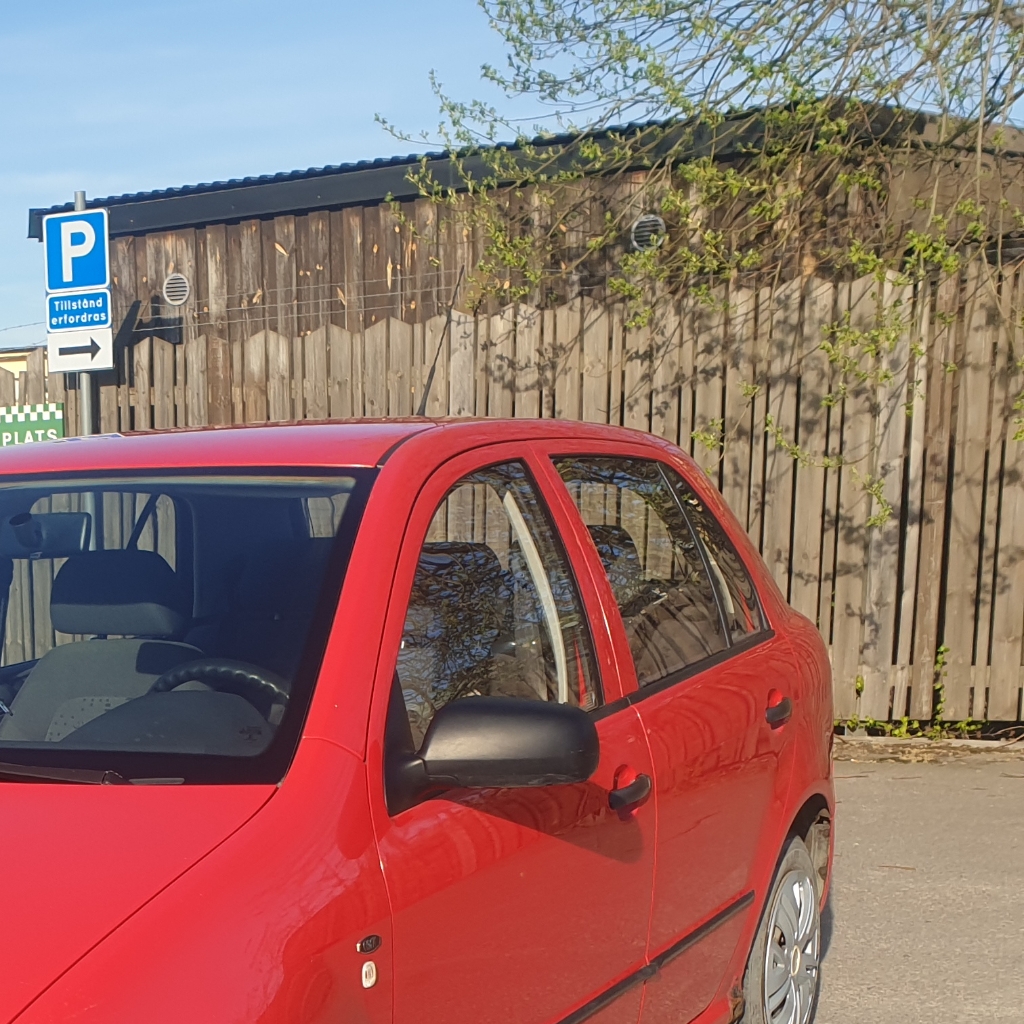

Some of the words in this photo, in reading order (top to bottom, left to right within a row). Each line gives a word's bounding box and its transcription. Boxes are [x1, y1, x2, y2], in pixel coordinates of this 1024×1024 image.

[61, 220, 96, 282] P
[54, 297, 103, 311] Tillstånd
[51, 312, 107, 325] erfordras
